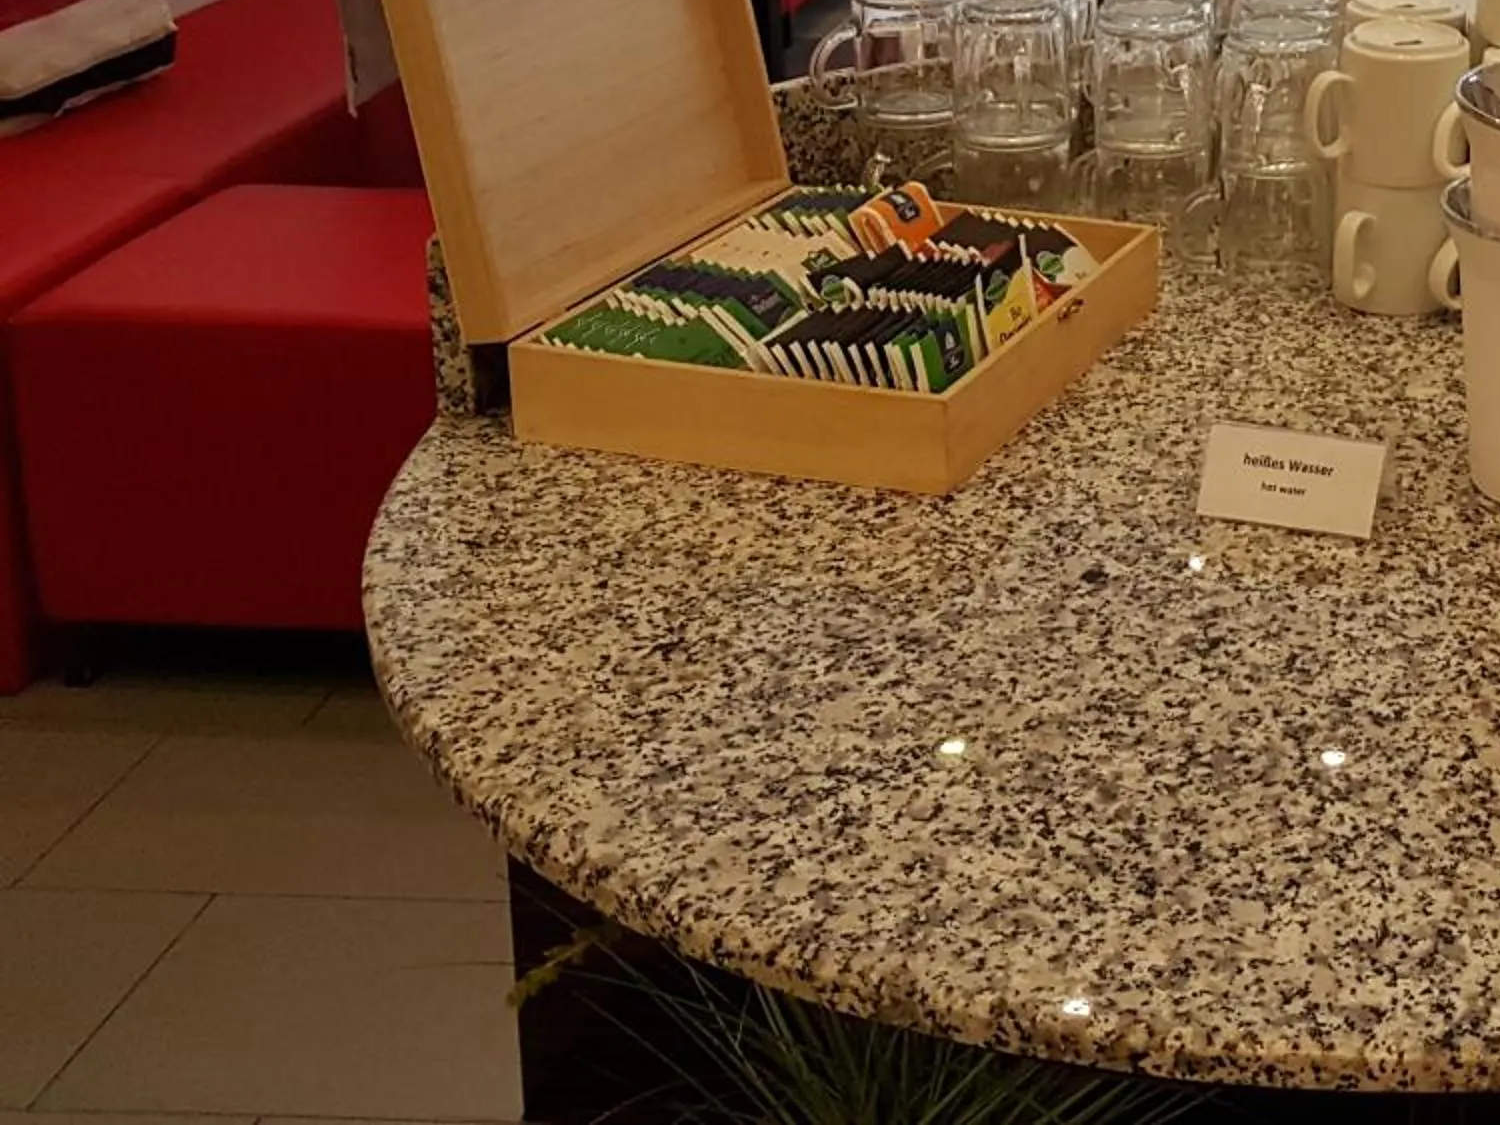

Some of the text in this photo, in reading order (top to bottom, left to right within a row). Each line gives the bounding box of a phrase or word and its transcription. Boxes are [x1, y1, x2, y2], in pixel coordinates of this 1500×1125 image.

[1243, 452, 1334, 477] heißes Wasser
[1261, 480, 1307, 496] hot water
